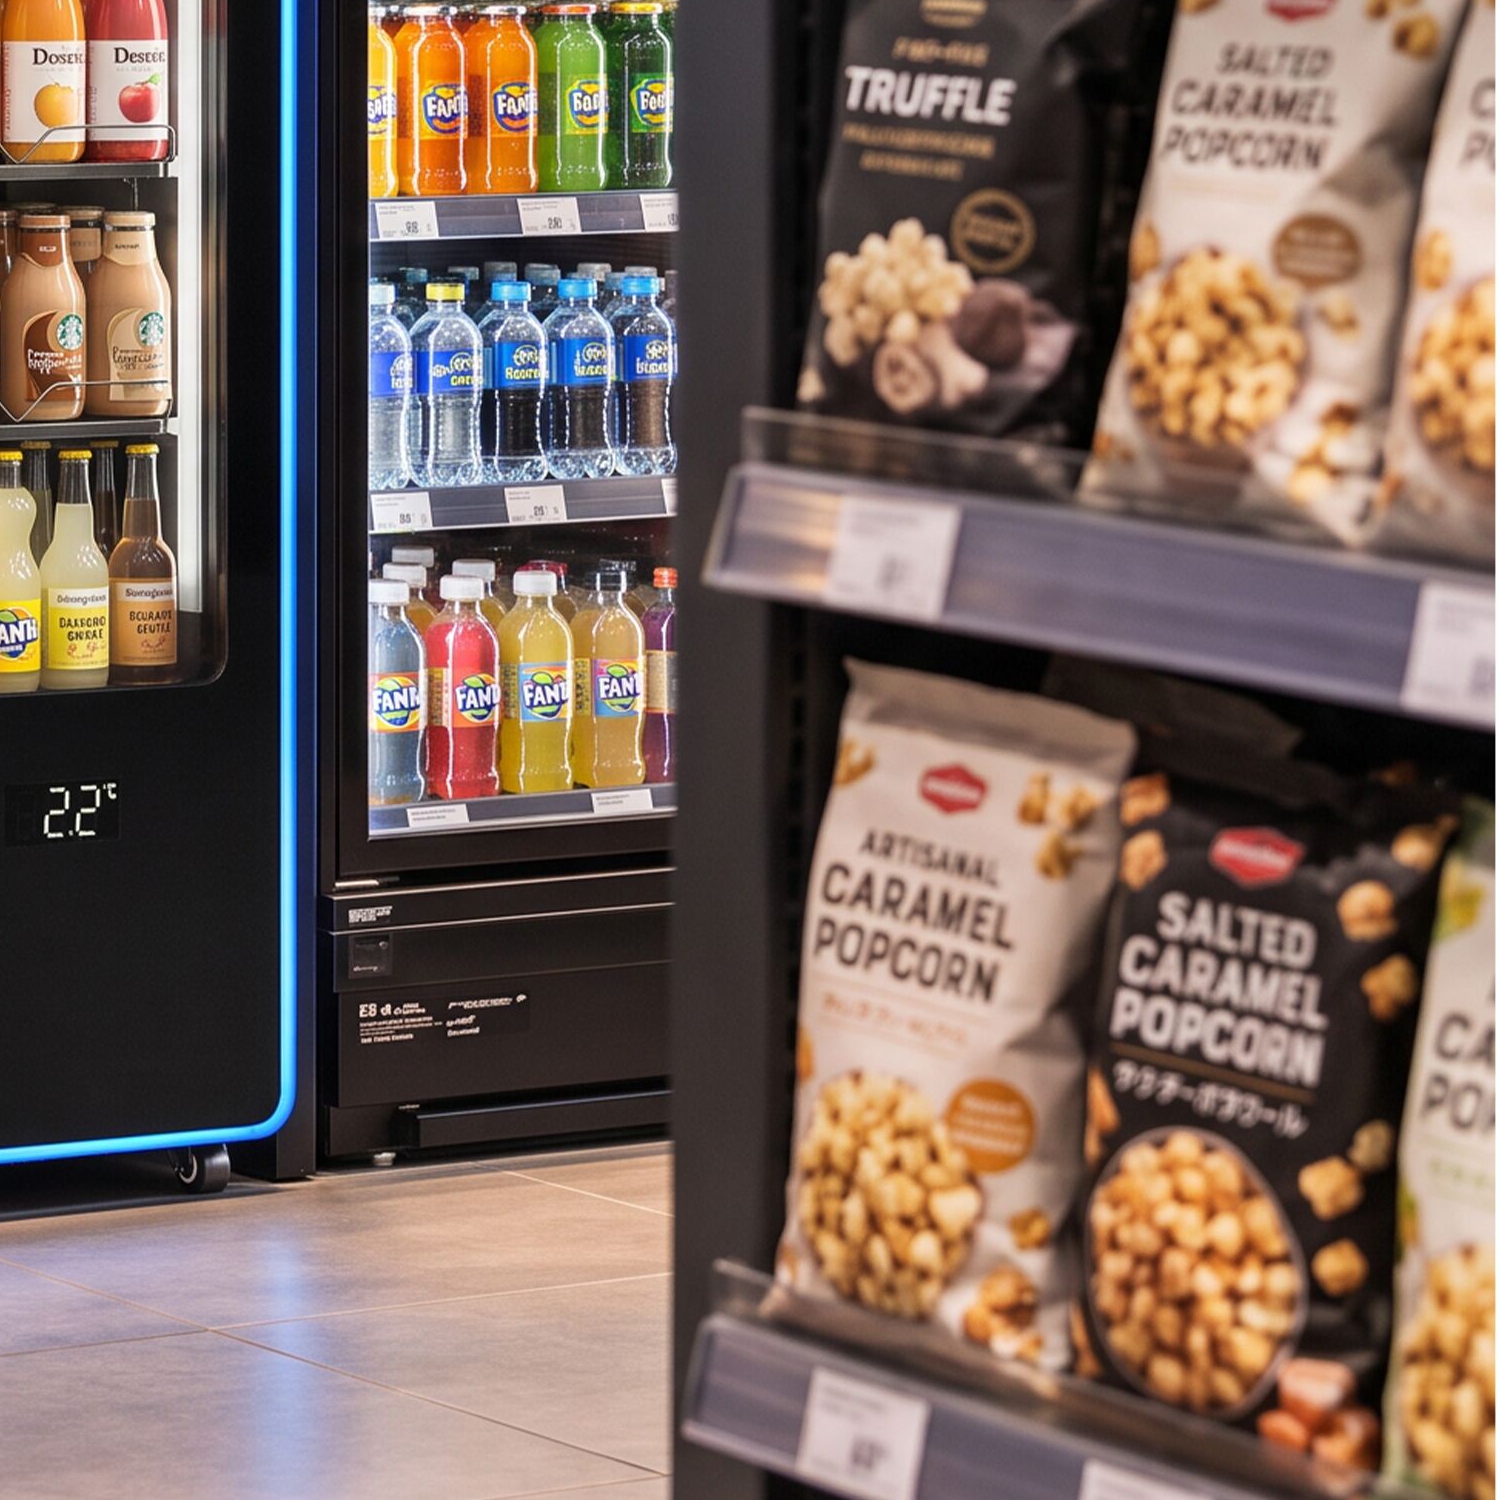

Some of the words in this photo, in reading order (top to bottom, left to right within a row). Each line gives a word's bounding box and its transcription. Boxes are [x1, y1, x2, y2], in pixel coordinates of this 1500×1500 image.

[844, 65, 1018, 127] TRUFFLE
[1217, 42, 1335, 81] SALTED
[1170, 79, 1340, 129] CARAMEL
[1157, 124, 1330, 173] POPCORN
[860, 827, 1001, 888] ARTISANAL
[821, 862, 1015, 951] CARAMEL
[1156, 891, 1317, 970] SALTED
[812, 916, 1000, 1005] POPCORN
[1119, 934, 1330, 1030] CARAMEL
[1109, 985, 1325, 1089] POPCORN
